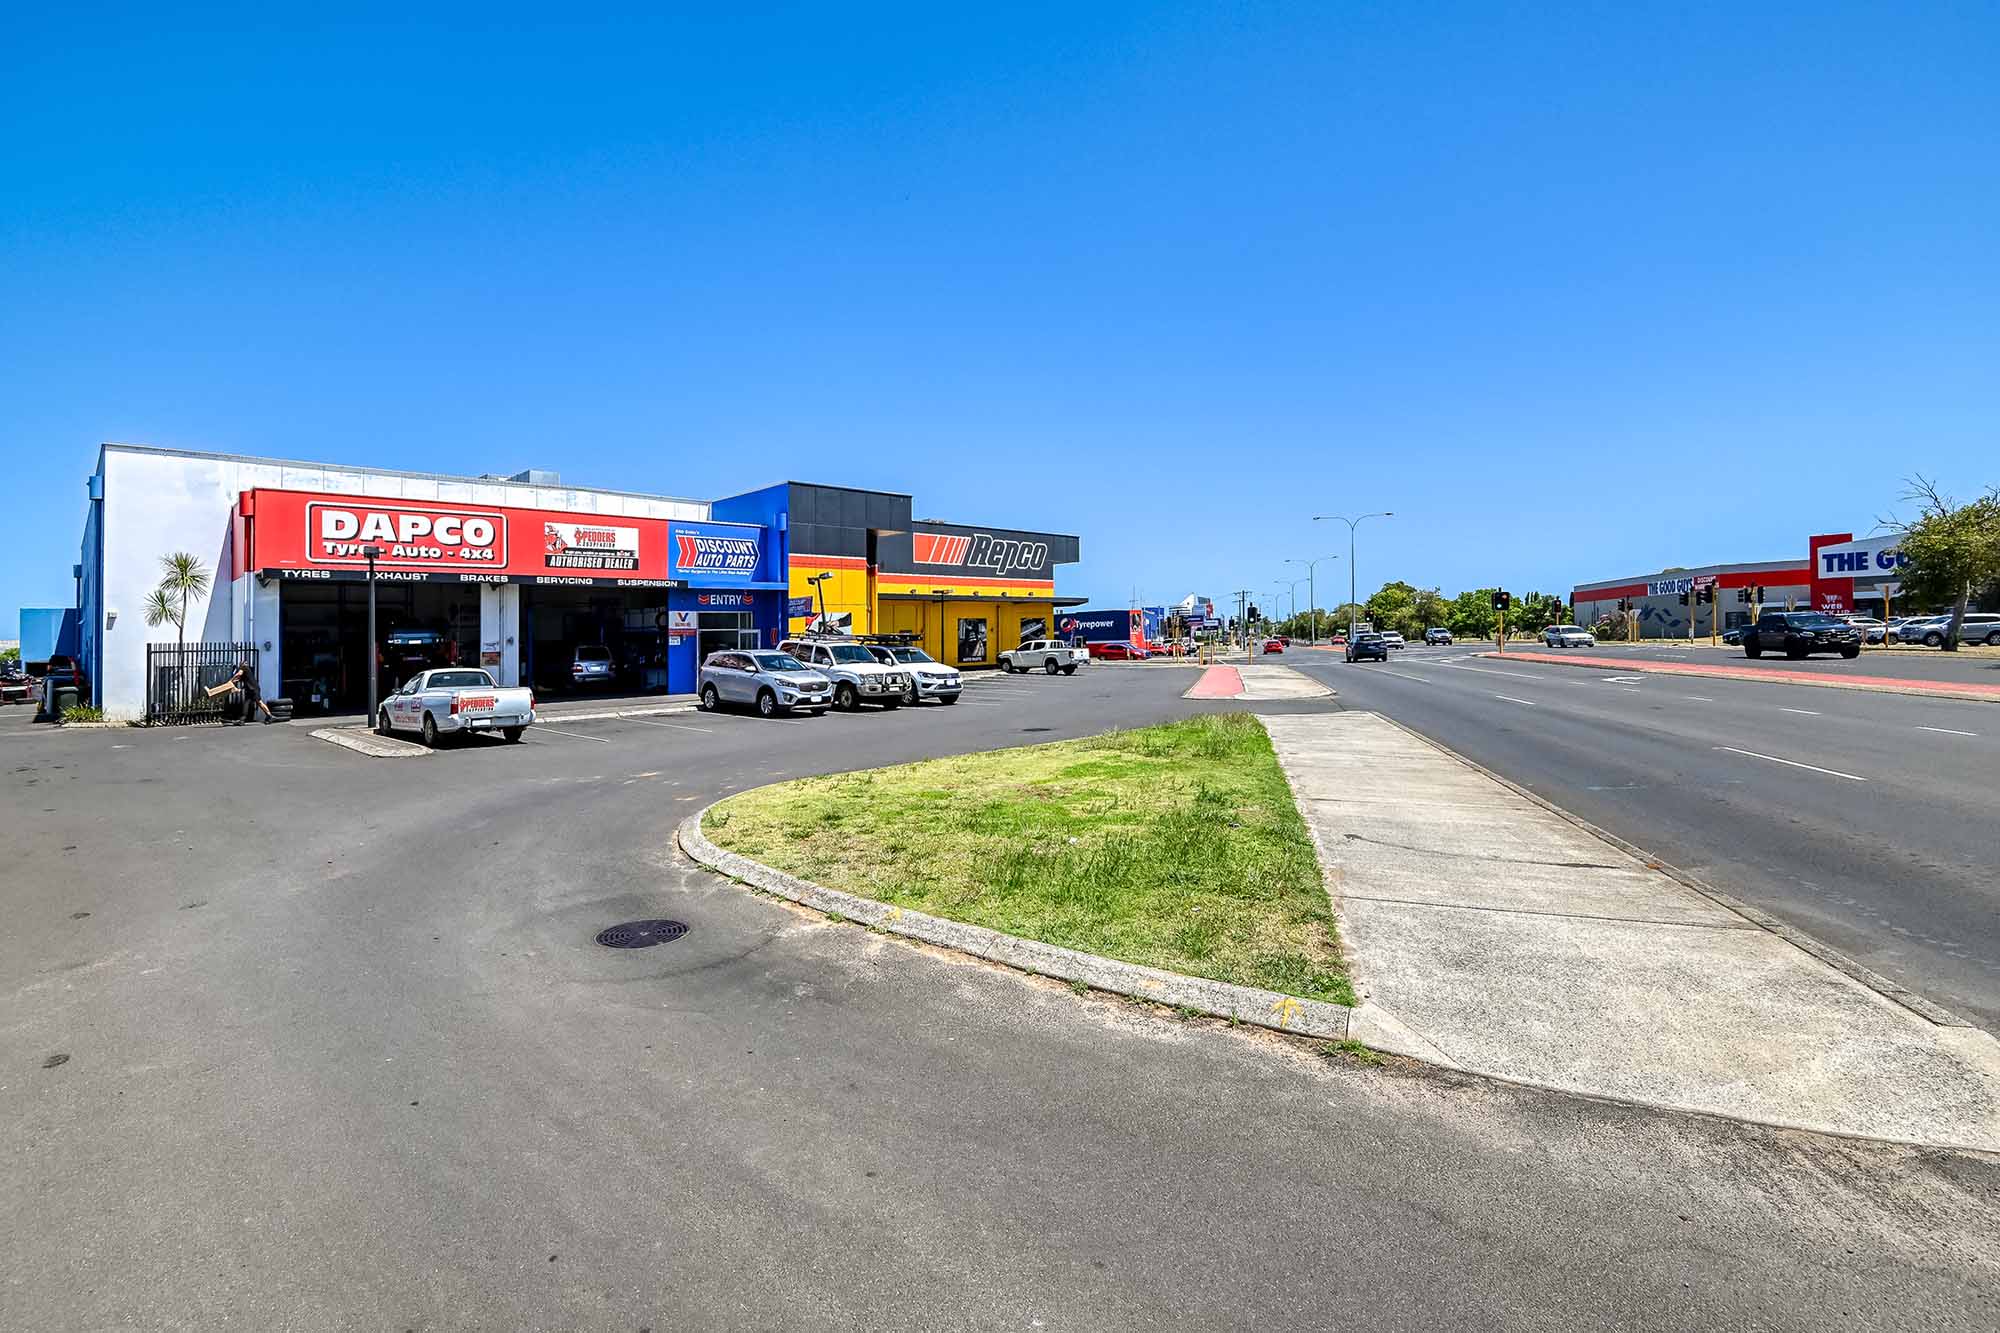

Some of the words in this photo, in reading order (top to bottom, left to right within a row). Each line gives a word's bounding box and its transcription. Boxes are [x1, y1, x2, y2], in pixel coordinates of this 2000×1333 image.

[321, 510, 496, 547] DAPCO
[582, 531, 616, 543] PEDDERS
[391, 545, 441, 559] Auto
[459, 547, 494, 560] 4x4
[695, 539, 755, 555] DISCOUNT
[968, 533, 1048, 575] Repco
[550, 557, 601, 569] AUTHORISED
[604, 558, 634, 569] DEALER
[695, 554, 723, 567] AUTO
[725, 555, 755, 568] PARTS
[1821, 552, 1868, 573] THE
[282, 570, 331, 579] TYRES
[460, 574, 509, 583] BRAKES
[536, 577, 593, 585] SERVICING
[1649, 582, 1658, 595] THE
[1660, 580, 1676, 594] GOOD
[1676, 578, 1692, 593] GUYS
[710, 594, 742, 605] ENTRY
[1075, 619, 1114, 630] Tyrepower
